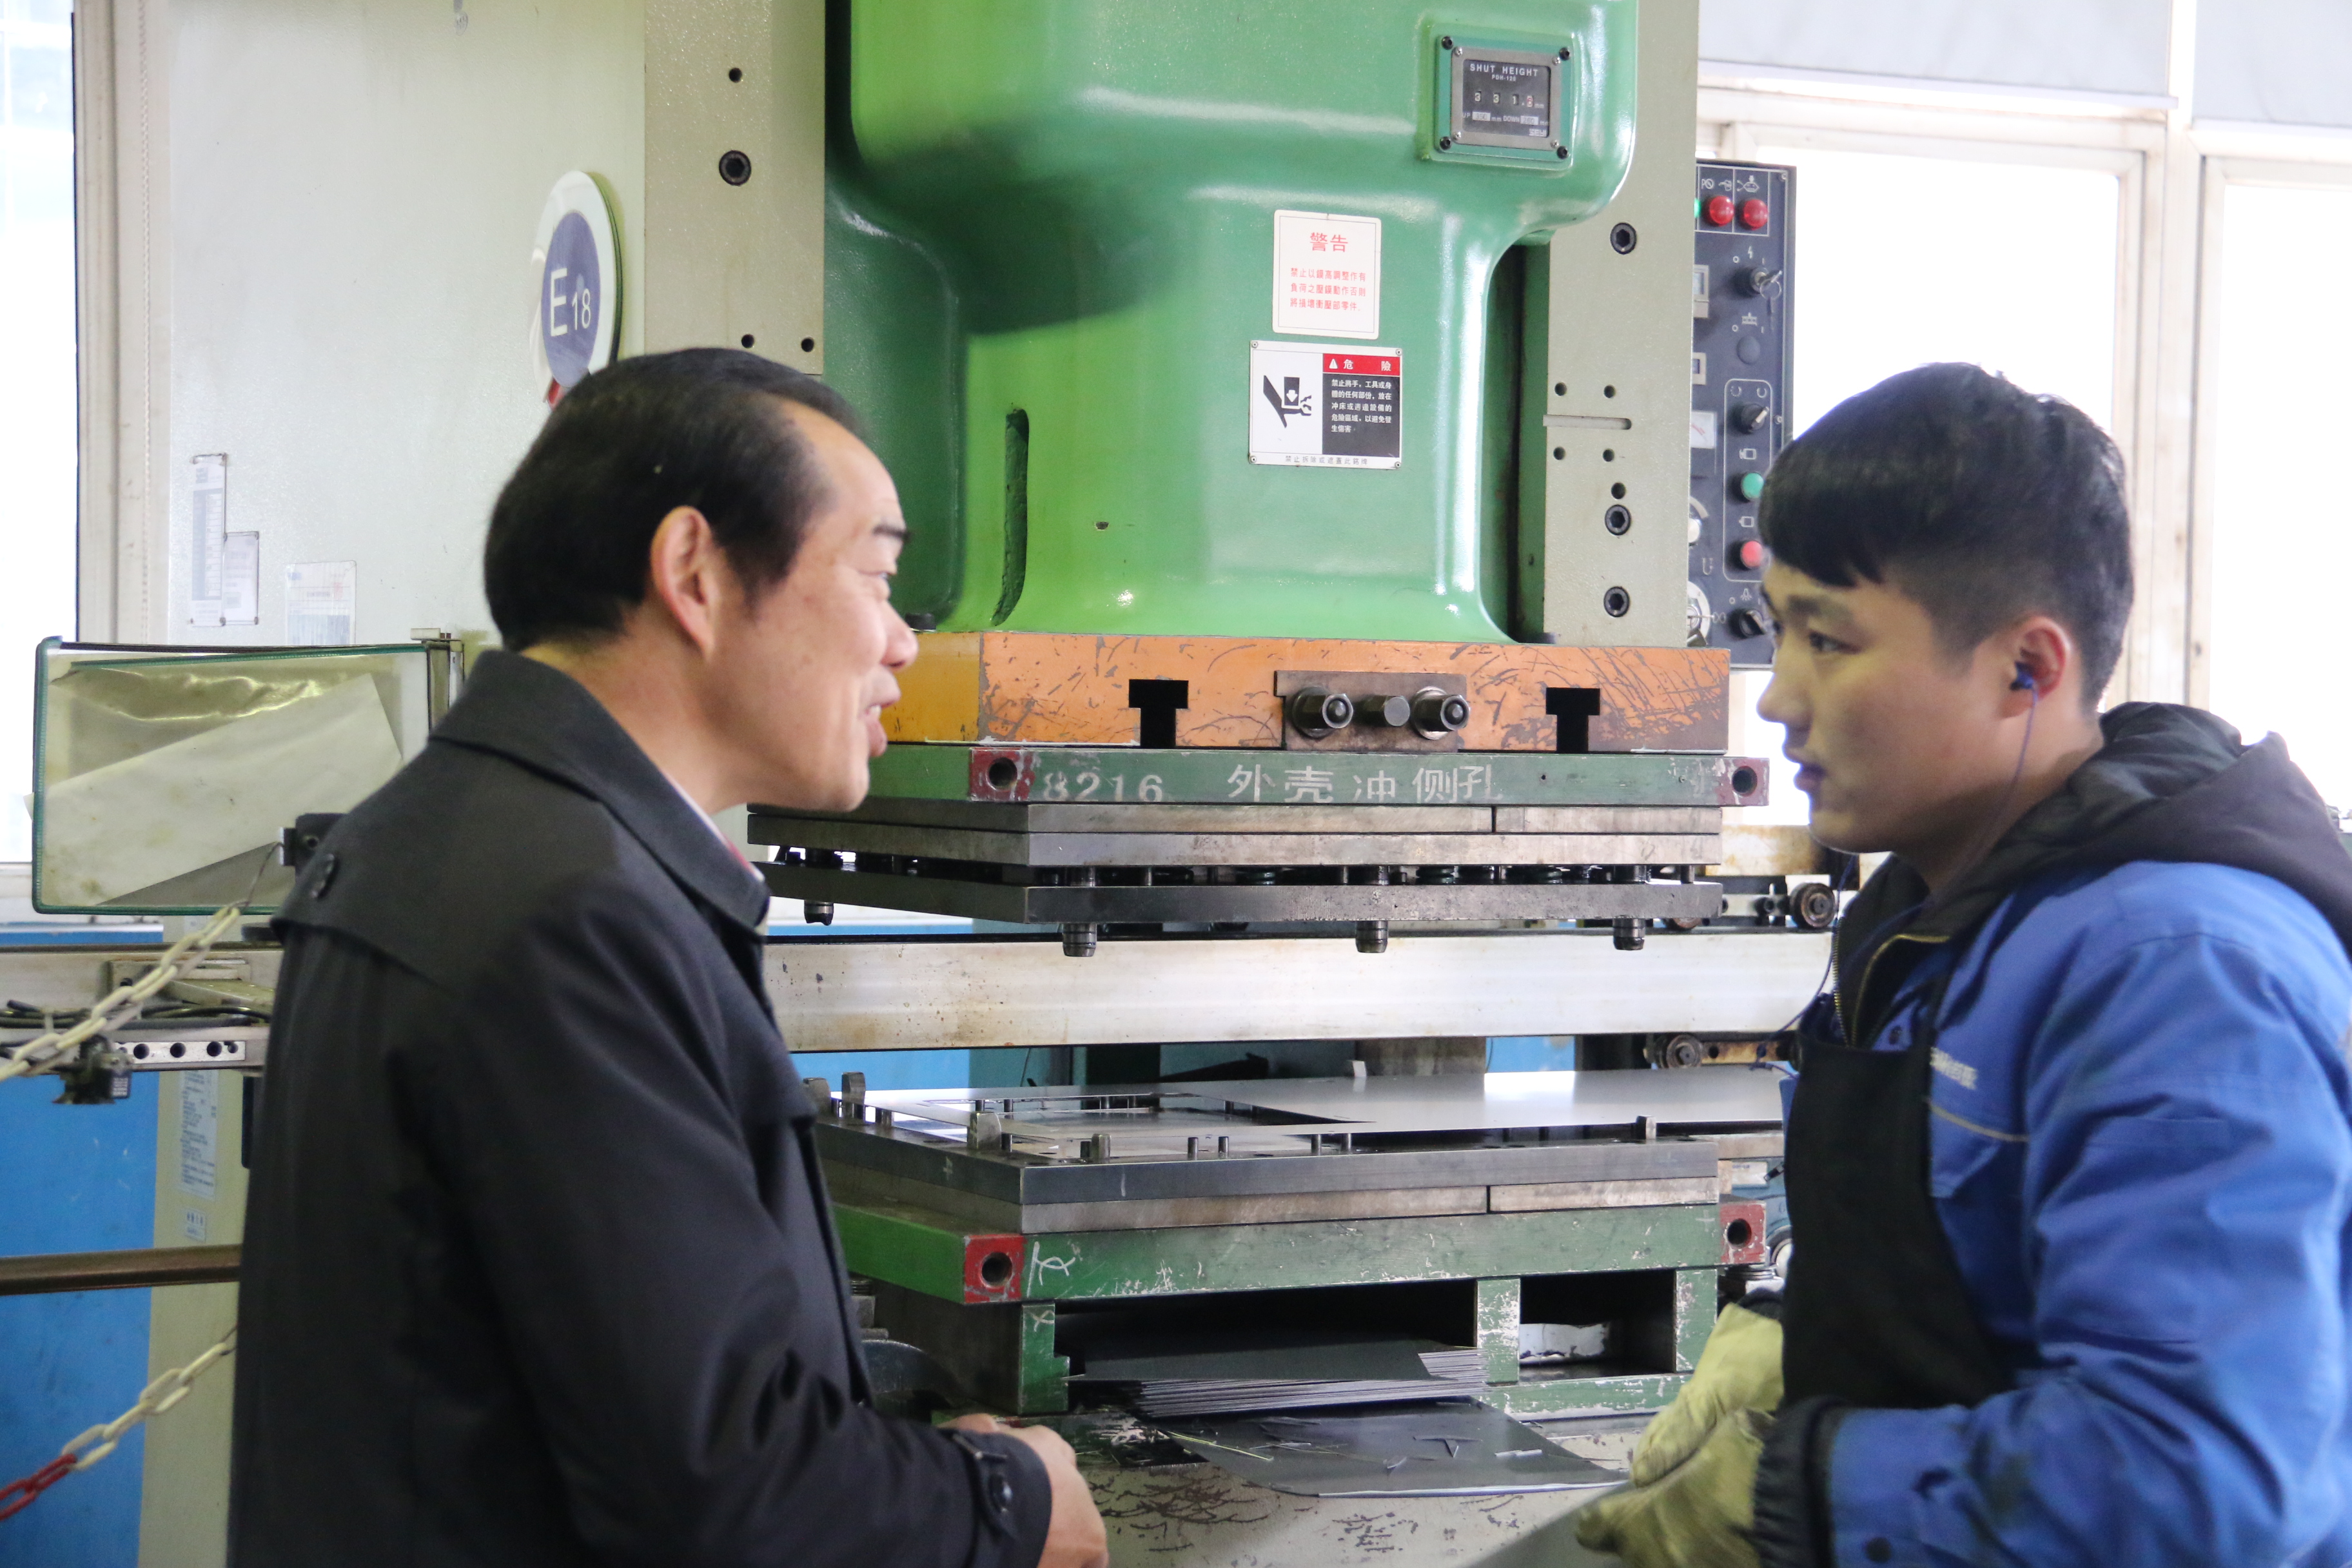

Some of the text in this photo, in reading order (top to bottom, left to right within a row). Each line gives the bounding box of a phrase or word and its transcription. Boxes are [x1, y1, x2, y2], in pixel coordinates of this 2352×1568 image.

[1470, 64, 1538, 77] SHUT HEIGHT
[1310, 232, 1349, 252] 警告
[1043, 763, 1504, 804] 8216 外壳冲侧孔
